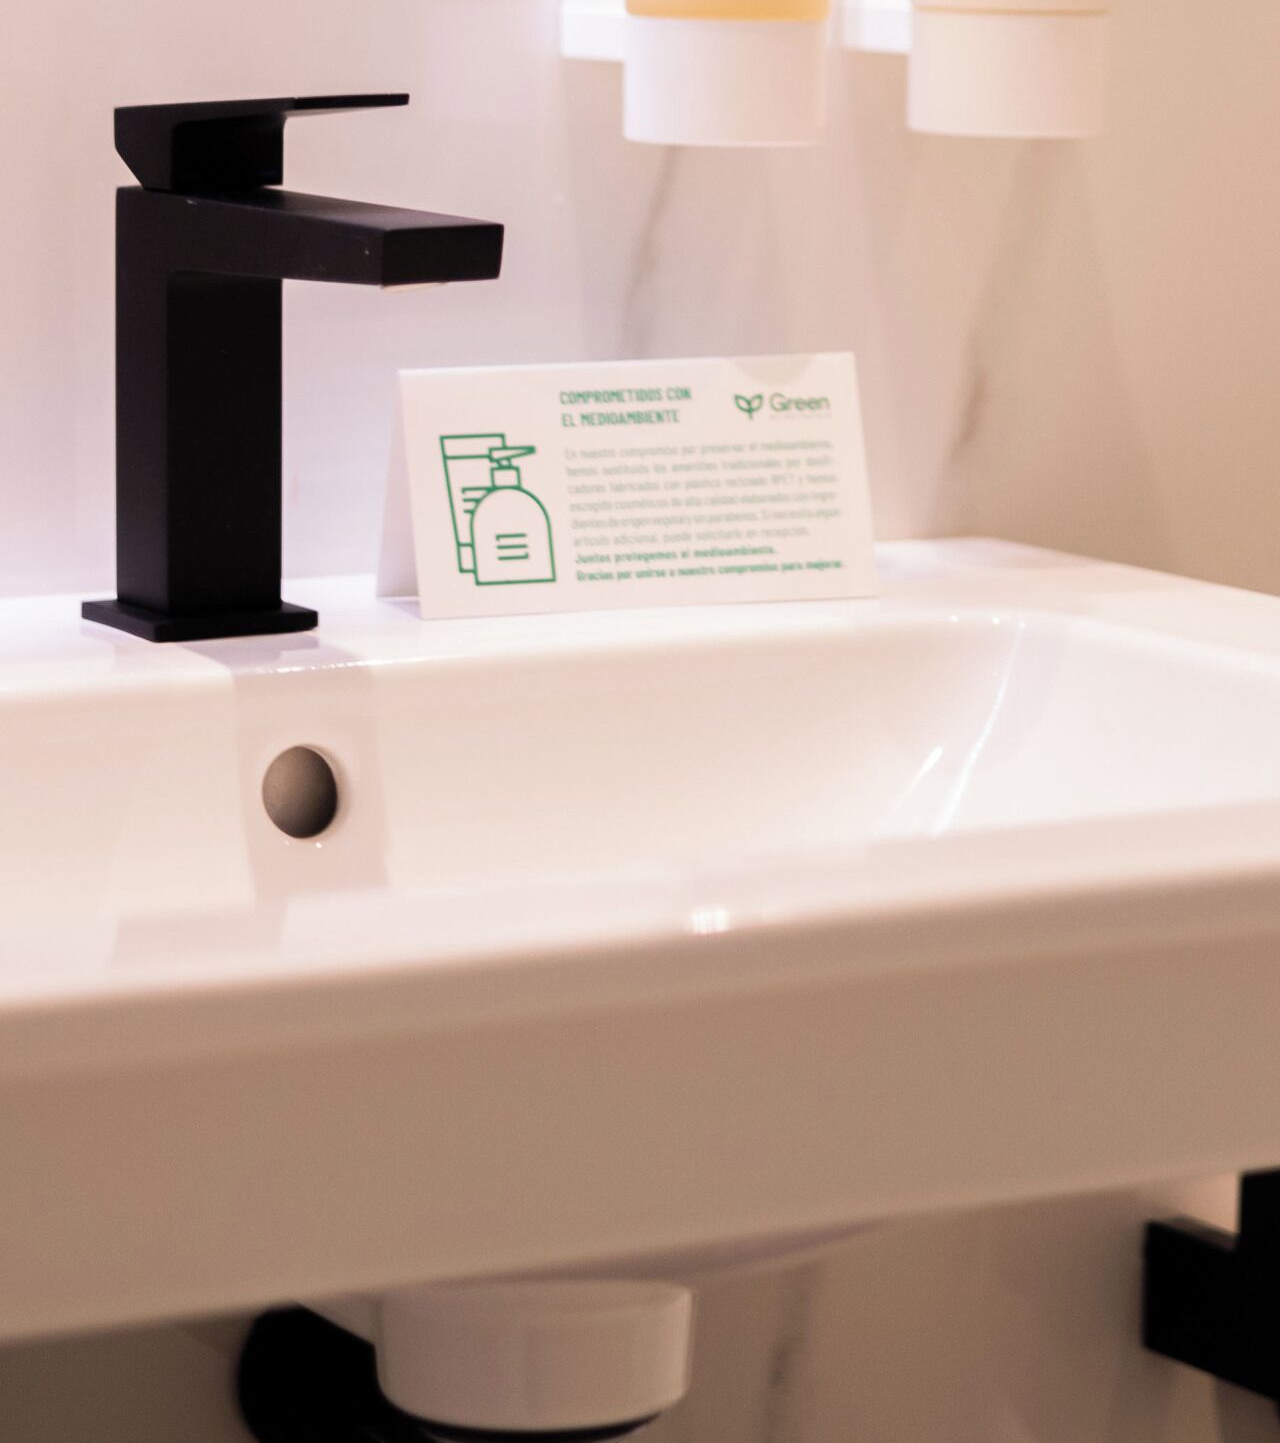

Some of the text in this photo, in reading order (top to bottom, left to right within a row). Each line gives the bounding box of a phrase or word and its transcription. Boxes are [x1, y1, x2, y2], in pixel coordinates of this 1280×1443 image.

[560, 386, 692, 406] COMPROMETIDOS CON
[769, 392, 831, 412] Green
[561, 409, 680, 428] EL MEDIOAMBIENTE
